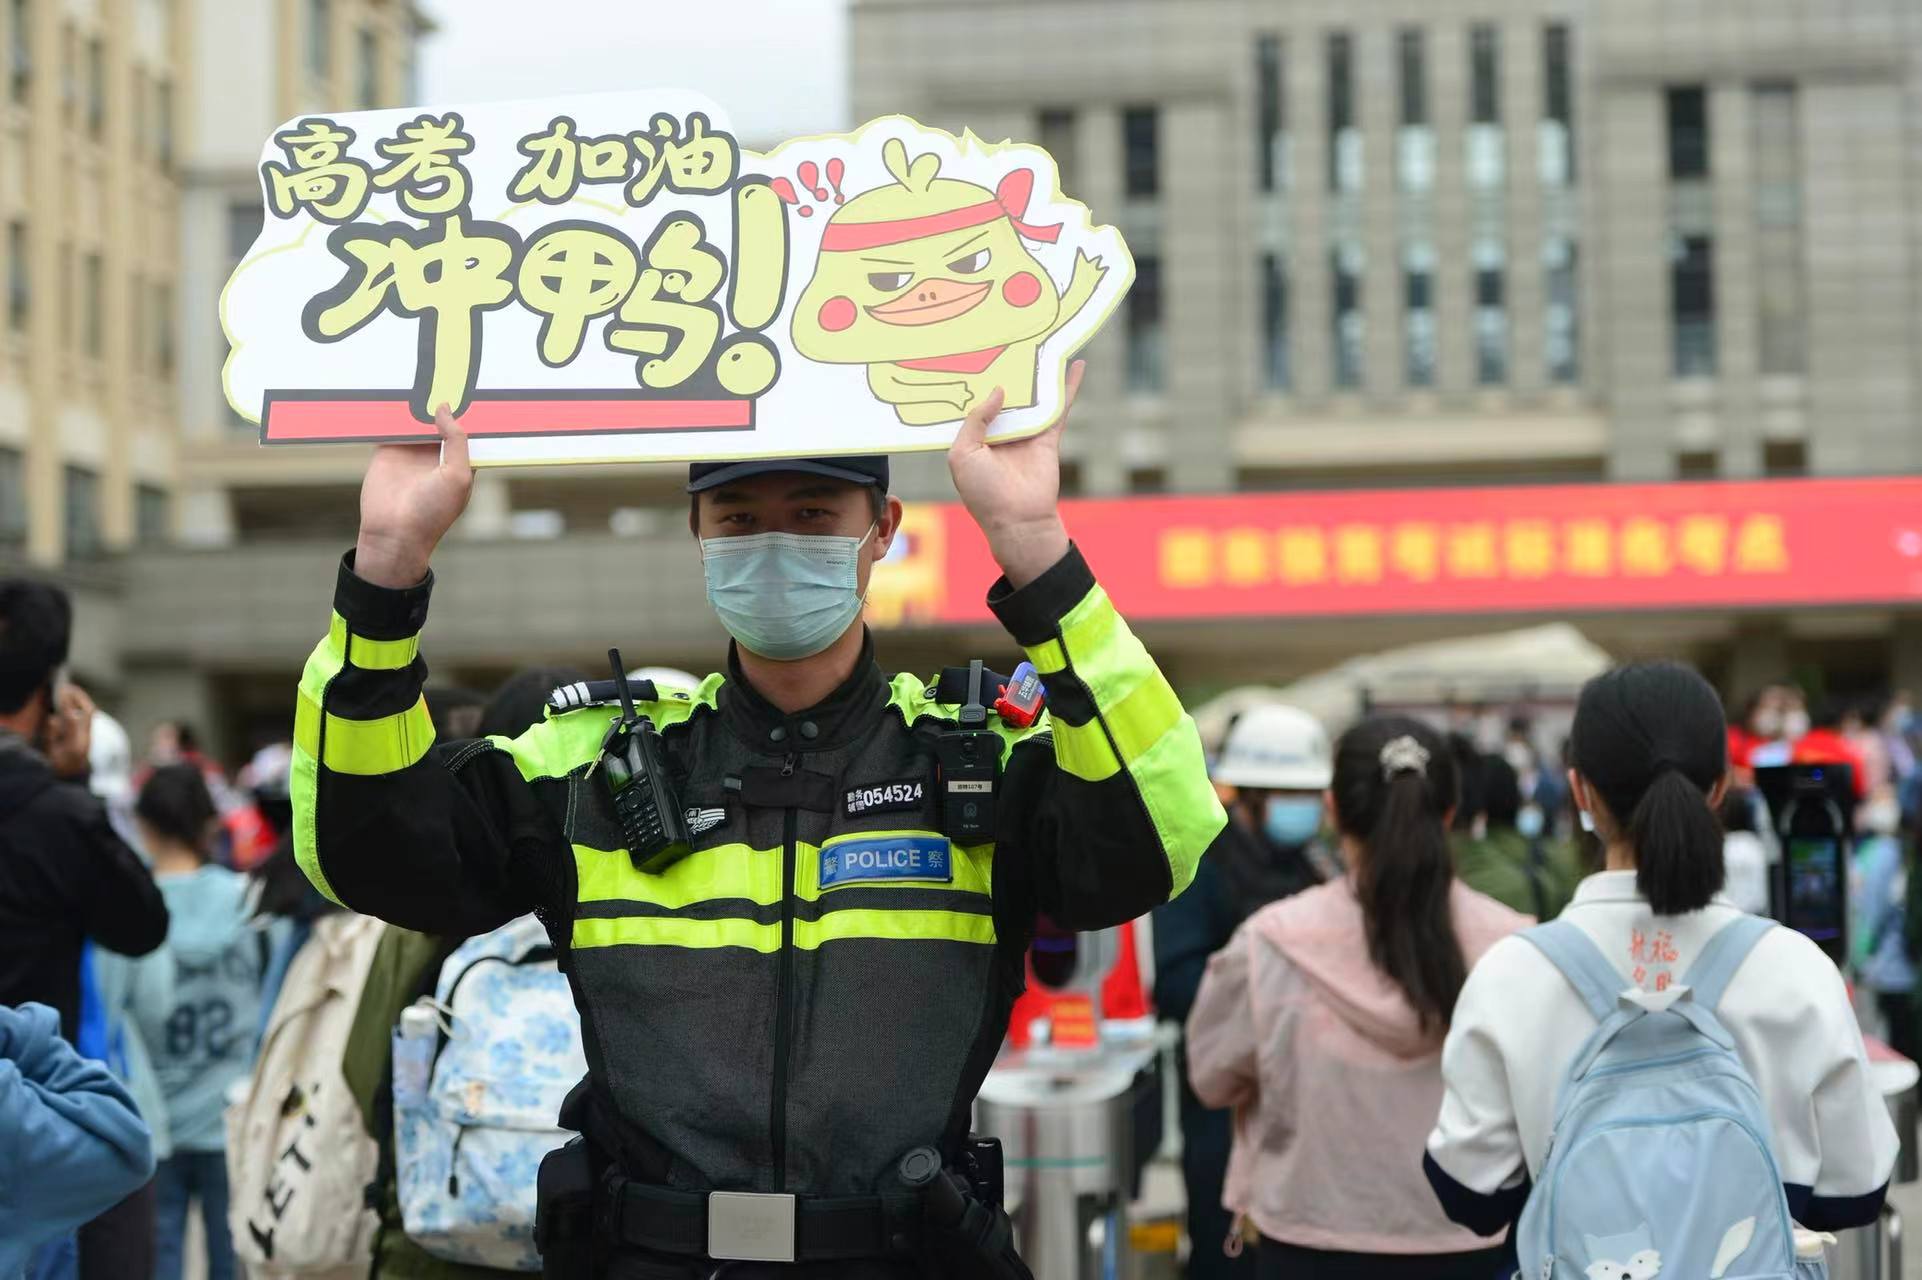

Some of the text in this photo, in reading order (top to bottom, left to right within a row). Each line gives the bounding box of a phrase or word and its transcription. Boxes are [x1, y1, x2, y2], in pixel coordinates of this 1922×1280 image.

[266, 111, 741, 223] 高考 加油
[863, 783, 922, 807] 054524
[824, 849, 944, 876] 警 POLICE 察
